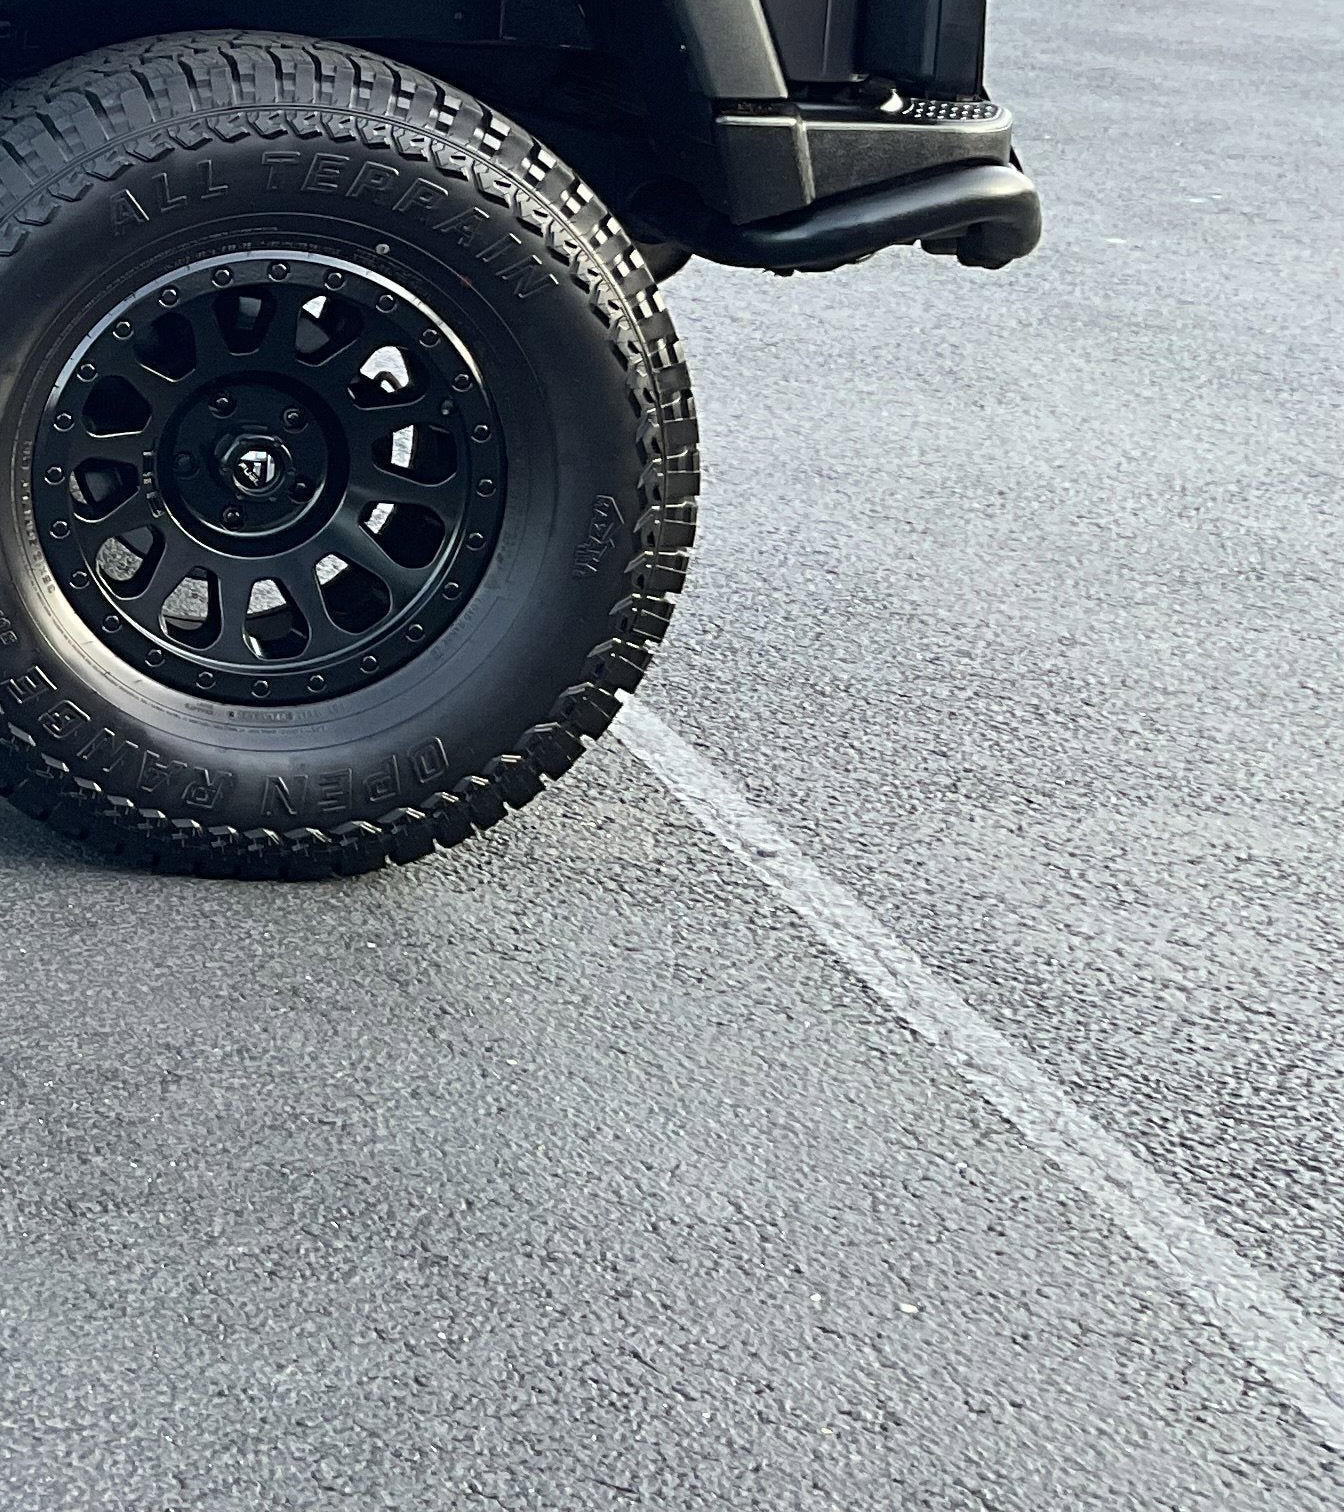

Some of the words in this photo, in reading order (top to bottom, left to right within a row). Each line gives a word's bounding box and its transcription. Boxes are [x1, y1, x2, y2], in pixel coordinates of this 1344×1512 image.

[109, 159, 231, 236] ALL
[261, 149, 560, 302] TERRAIN
[260, 736, 450, 816] OPEN
